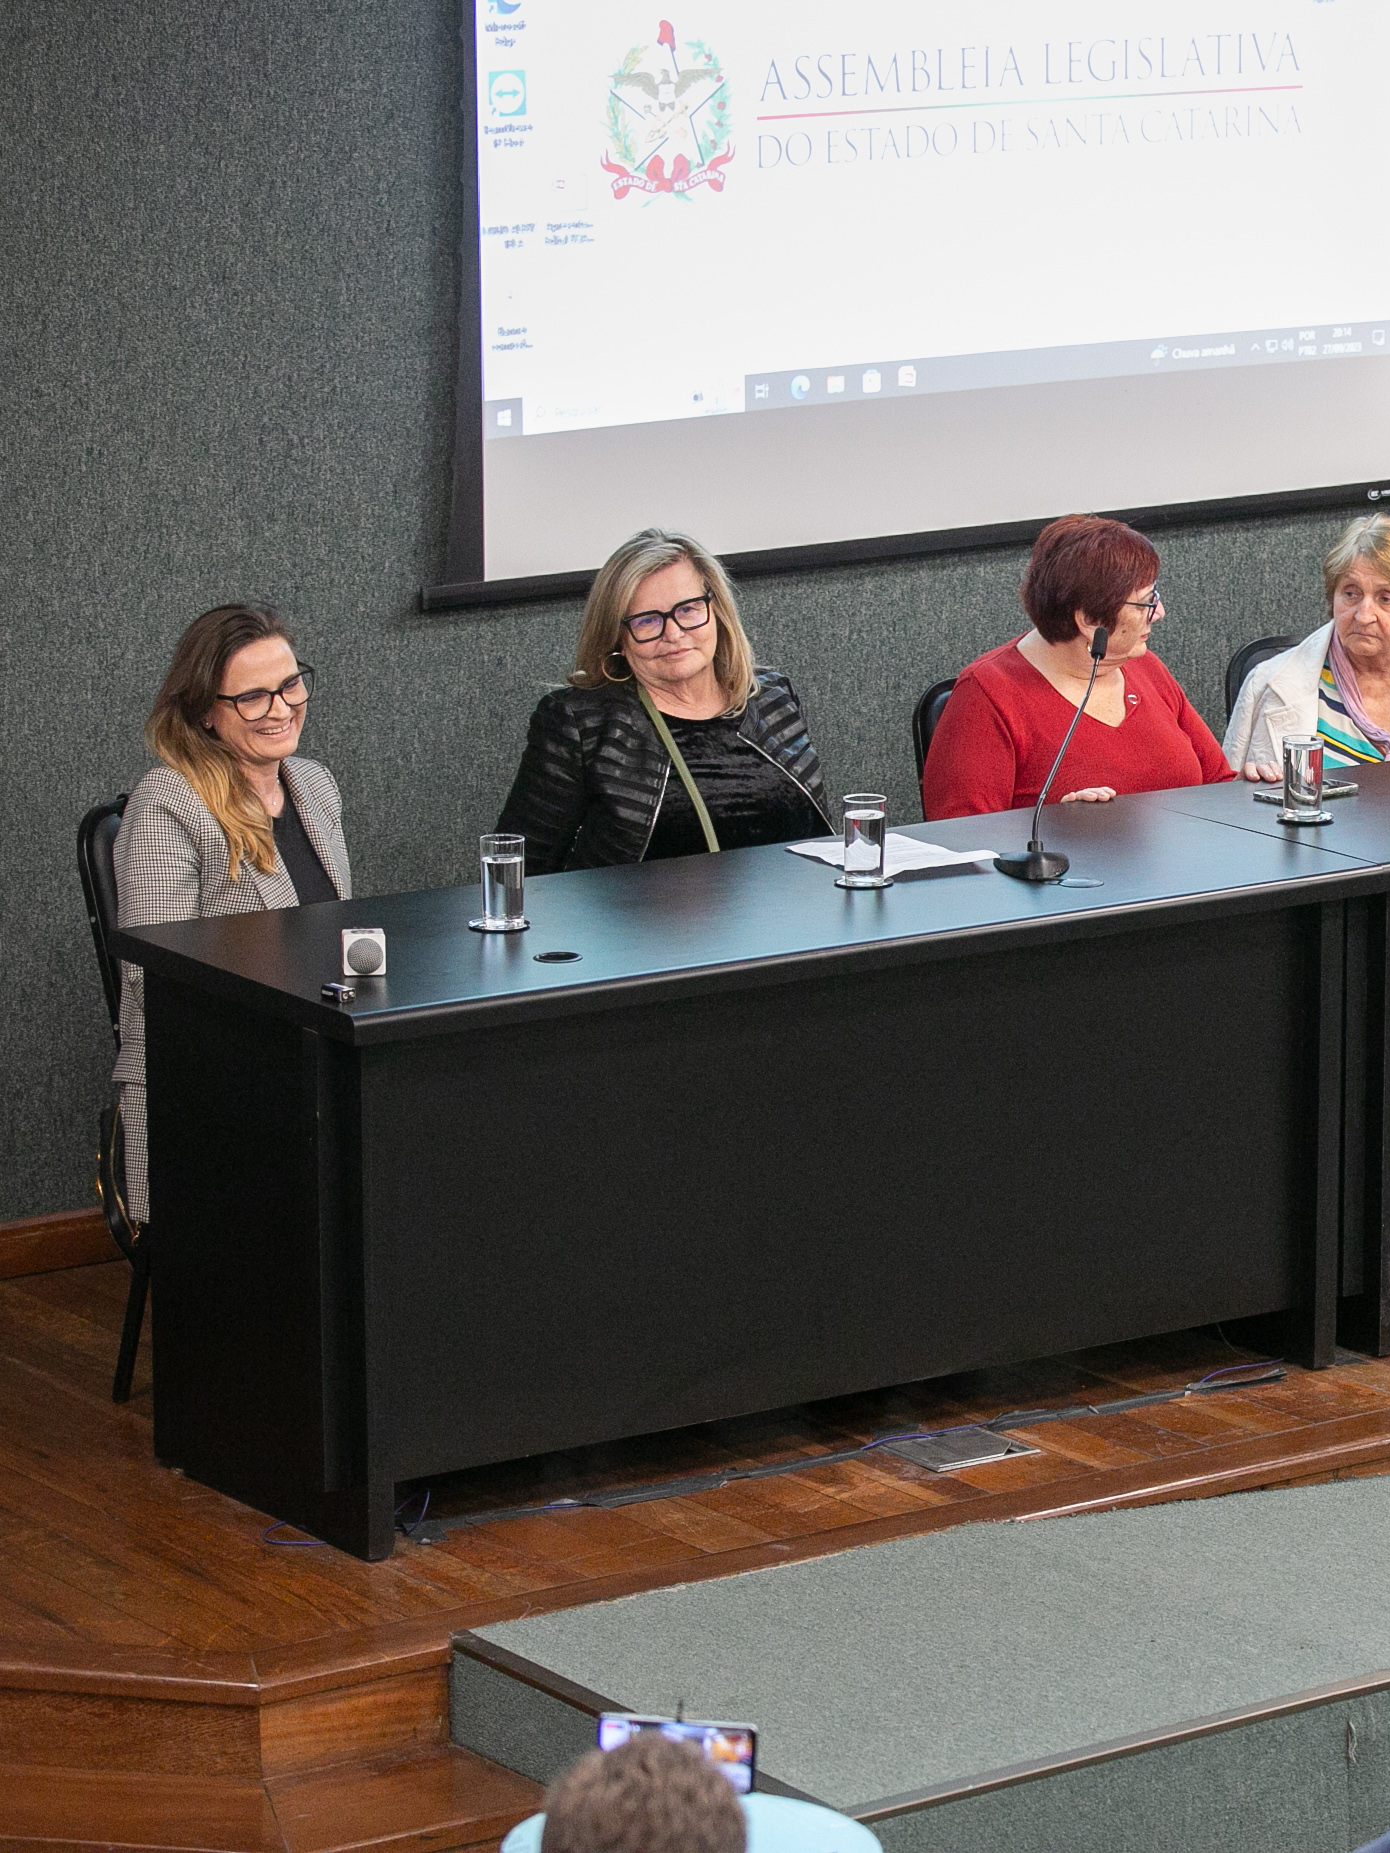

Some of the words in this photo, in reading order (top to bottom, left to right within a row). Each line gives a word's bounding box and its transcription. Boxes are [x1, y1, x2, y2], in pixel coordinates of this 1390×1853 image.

[759, 44, 1025, 102] ASSEMBLEIA
[1044, 31, 1300, 85] LEGISLATIVA
[757, 131, 813, 169] DO
[826, 122, 958, 164] ESTADO
[972, 118, 1013, 154] DE
[1026, 112, 1130, 151] SANTA
[1140, 103, 1302, 144] CATARINA
[612, 176, 645, 191] ESTADO
